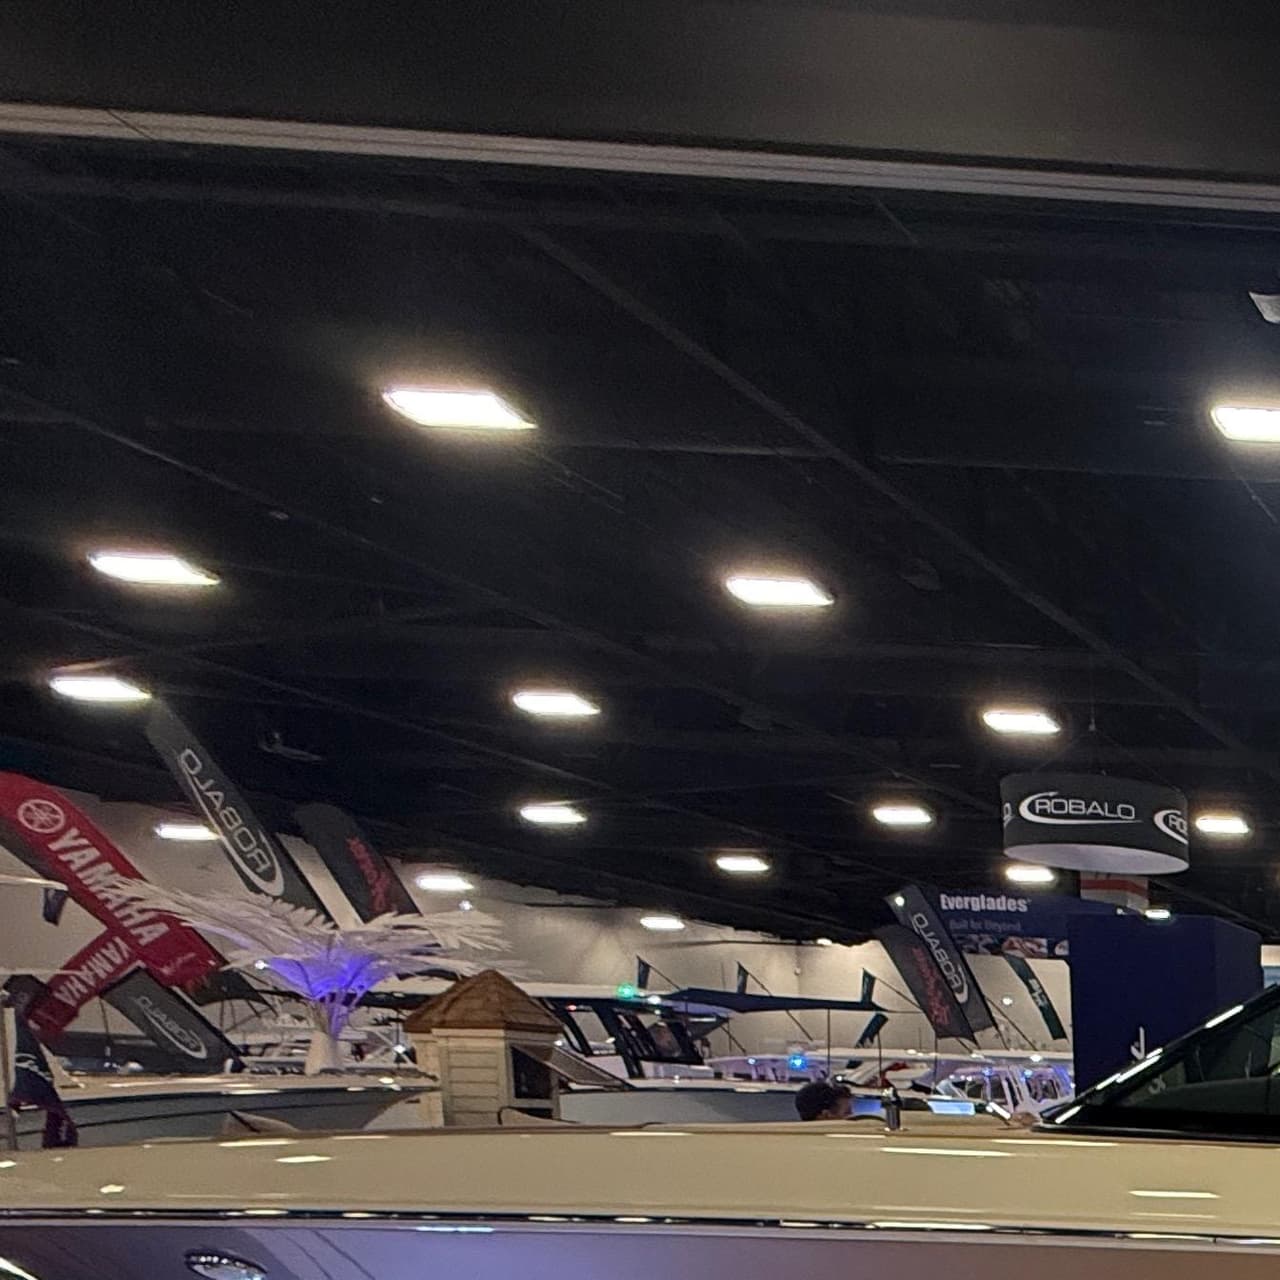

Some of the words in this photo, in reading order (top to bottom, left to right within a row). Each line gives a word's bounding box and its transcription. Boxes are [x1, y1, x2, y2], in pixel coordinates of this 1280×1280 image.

[1034, 798, 1136, 821] ROBALO
[48, 828, 170, 946] YAMAHA
[940, 893, 1028, 912] Everglades
